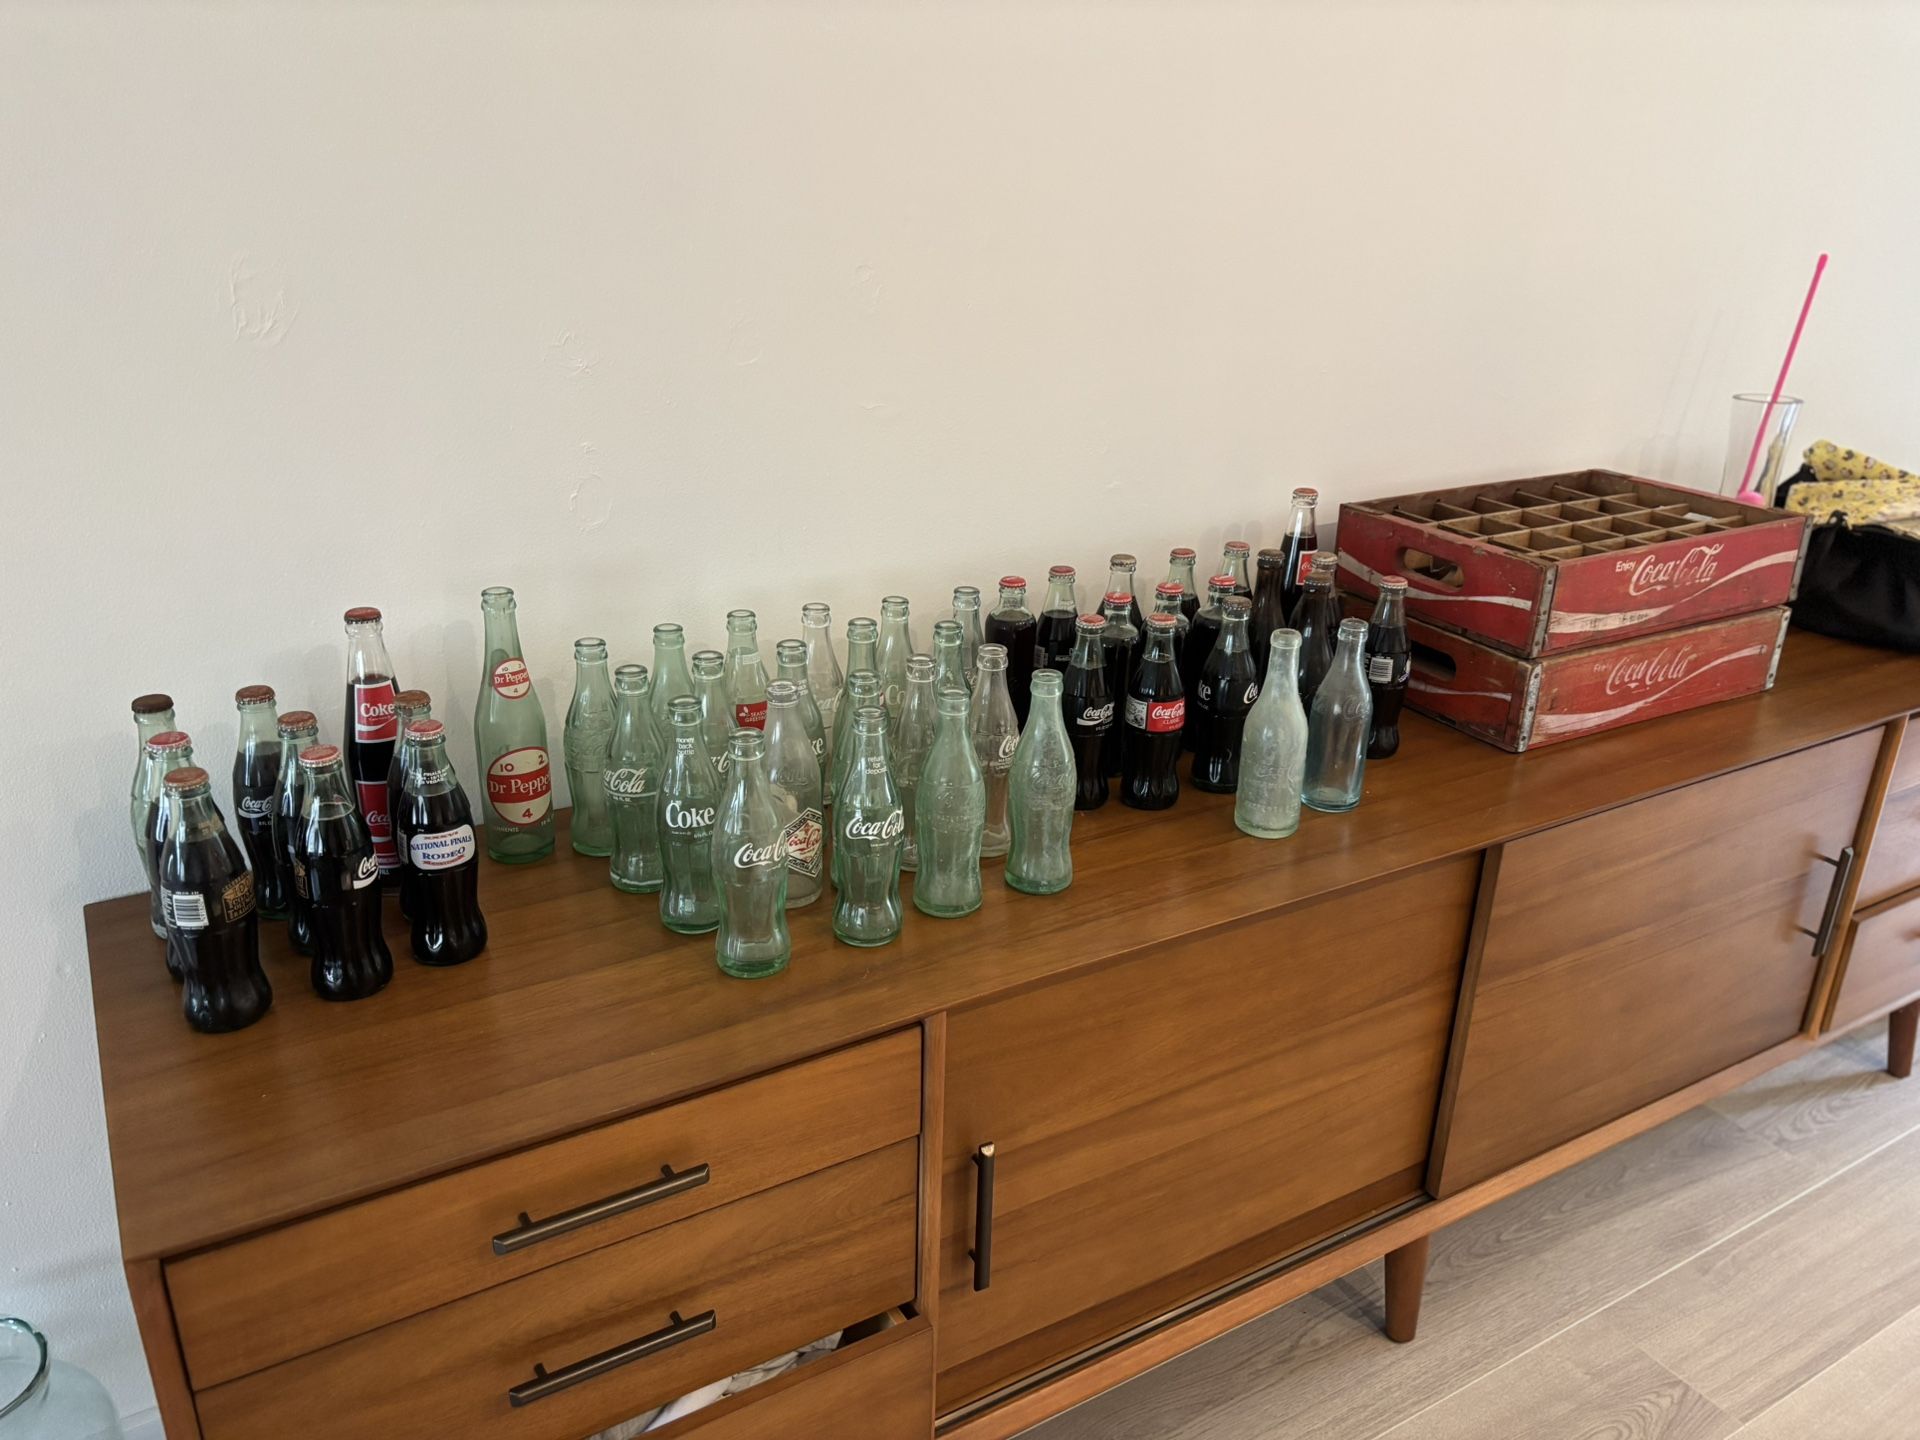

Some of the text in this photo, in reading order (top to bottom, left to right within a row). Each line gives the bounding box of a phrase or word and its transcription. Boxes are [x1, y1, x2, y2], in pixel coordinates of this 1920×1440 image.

[1615, 543, 1724, 596] Enjoy Coca-Cola
[494, 671, 529, 684] Dr Peppe
[360, 702, 396, 718] Coke
[500, 754, 544, 772] 10 2
[489, 774, 550, 796] Dr Peppe
[522, 807, 533, 818] 4
[665, 802, 716, 829] Coke
[410, 840, 450, 852] NATIONAL
[451, 834, 472, 846] FINALS
[421, 846, 466, 860] RODEO
